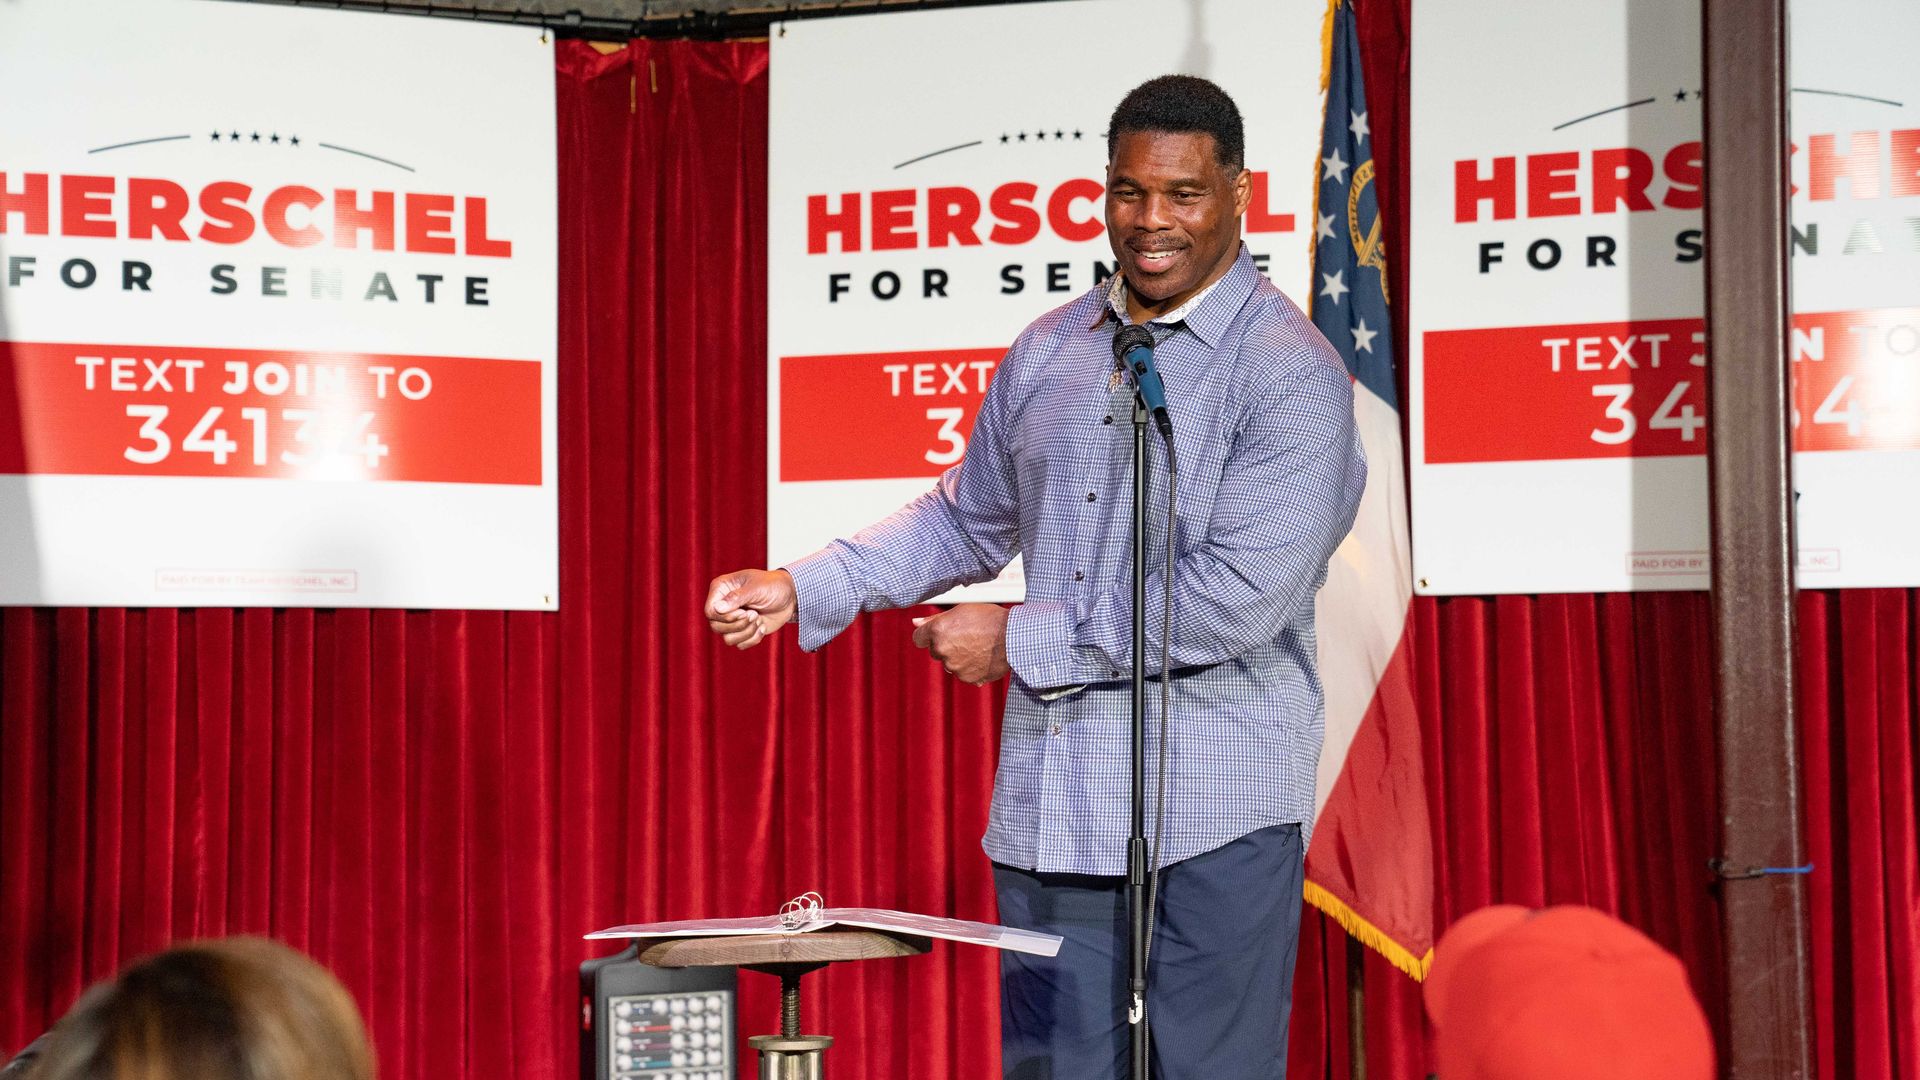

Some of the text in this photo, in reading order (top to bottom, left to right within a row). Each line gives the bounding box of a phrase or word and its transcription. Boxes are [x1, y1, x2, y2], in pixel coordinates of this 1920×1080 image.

[1454, 127, 1920, 223] HERSHE
[0, 171, 512, 258] HERSCHEL
[807, 171, 1295, 255] HERSCL
[829, 254, 1271, 303] FOR SEN
[1478, 236, 1617, 274] FOR
[8, 255, 490, 306] FOR SENATE
[1542, 333, 1670, 372] TEXT
[1848, 325, 1920, 358] TO
[75, 356, 433, 401] TEXT JOIN TO
[882, 360, 996, 397] TEXT
[1590, 374, 1864, 445] 344
[123, 404, 389, 469] 34134
[1662, 558, 1686, 568] FOR
